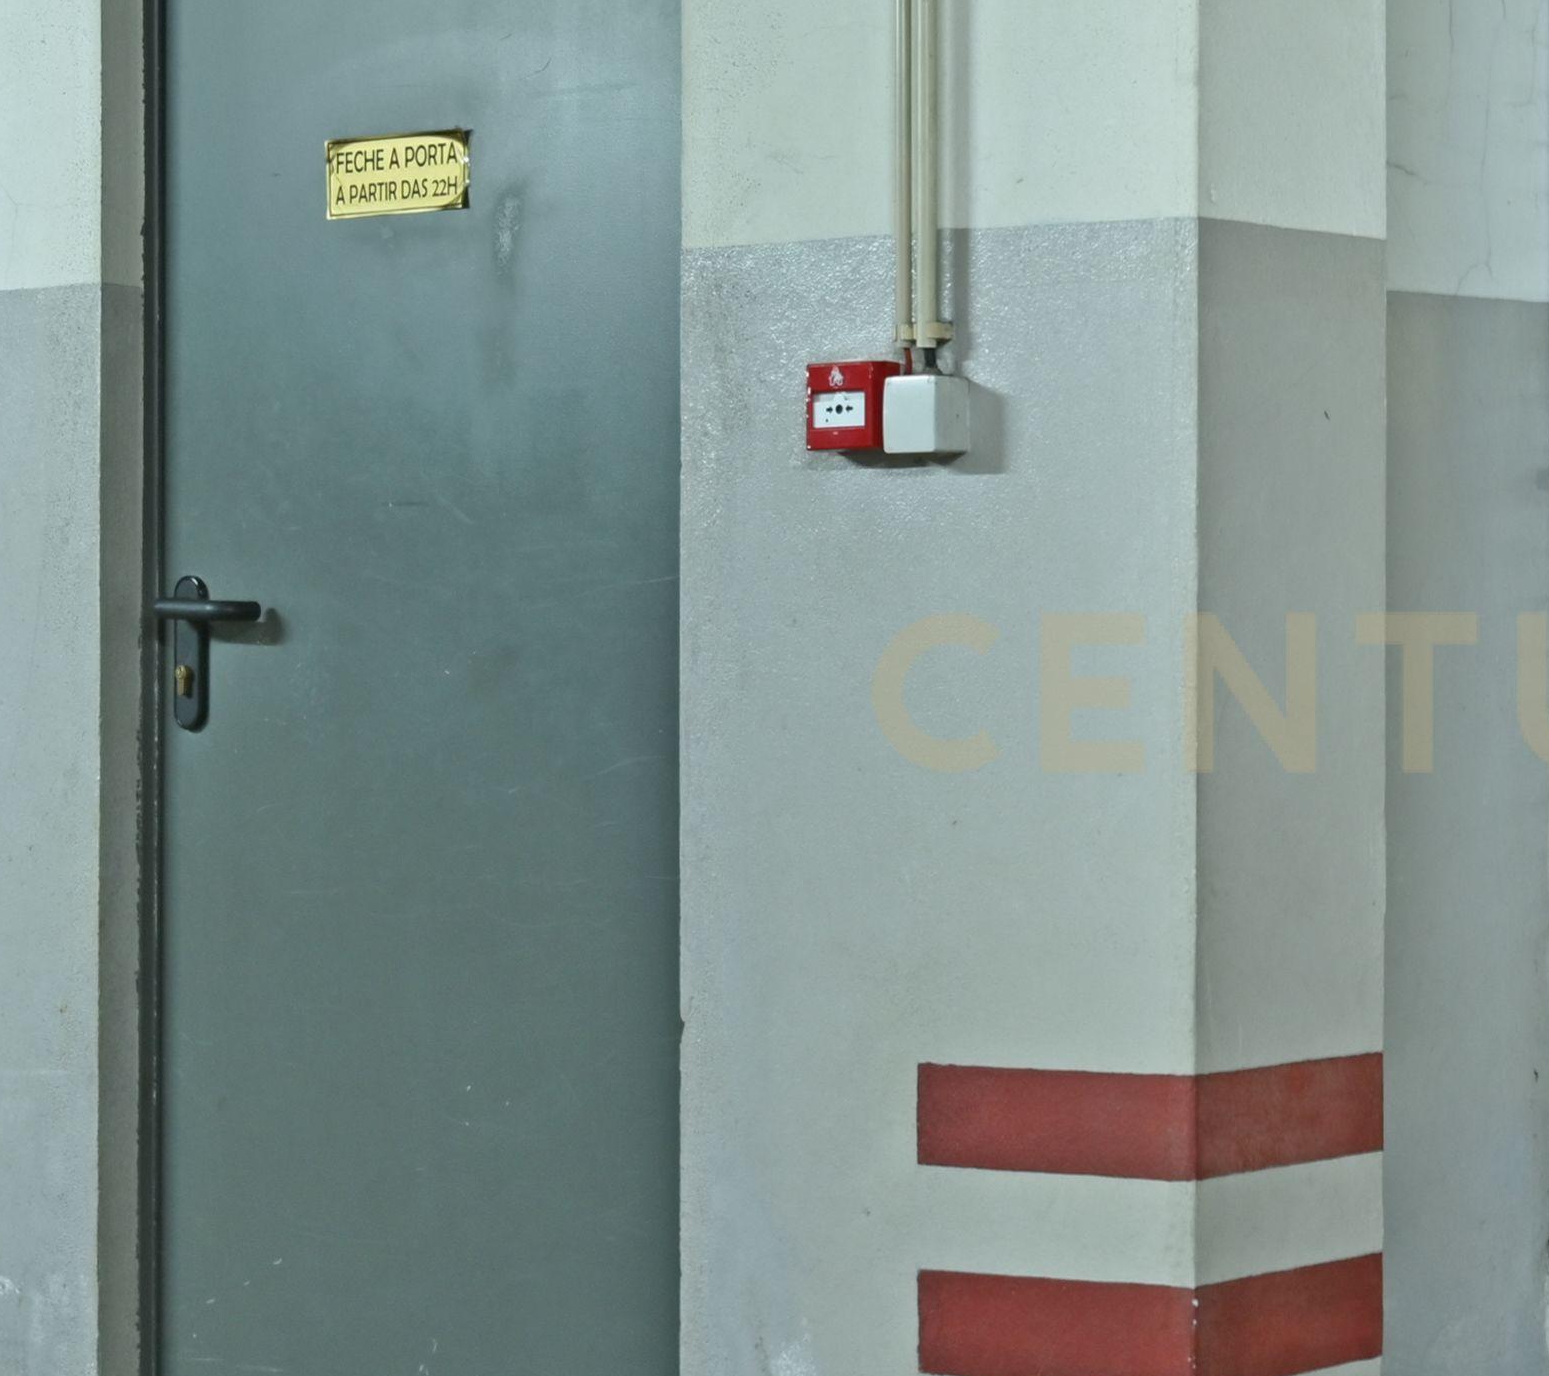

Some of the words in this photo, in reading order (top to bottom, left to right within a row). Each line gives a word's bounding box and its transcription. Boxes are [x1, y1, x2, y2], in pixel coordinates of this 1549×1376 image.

[336, 149, 384, 174] FECHE
[389, 148, 400, 170] A
[404, 141, 458, 168] PORTA
[336, 186, 345, 205] A
[349, 181, 397, 204] PARTIR
[401, 178, 428, 200] DAS
[432, 175, 458, 197] 22H
